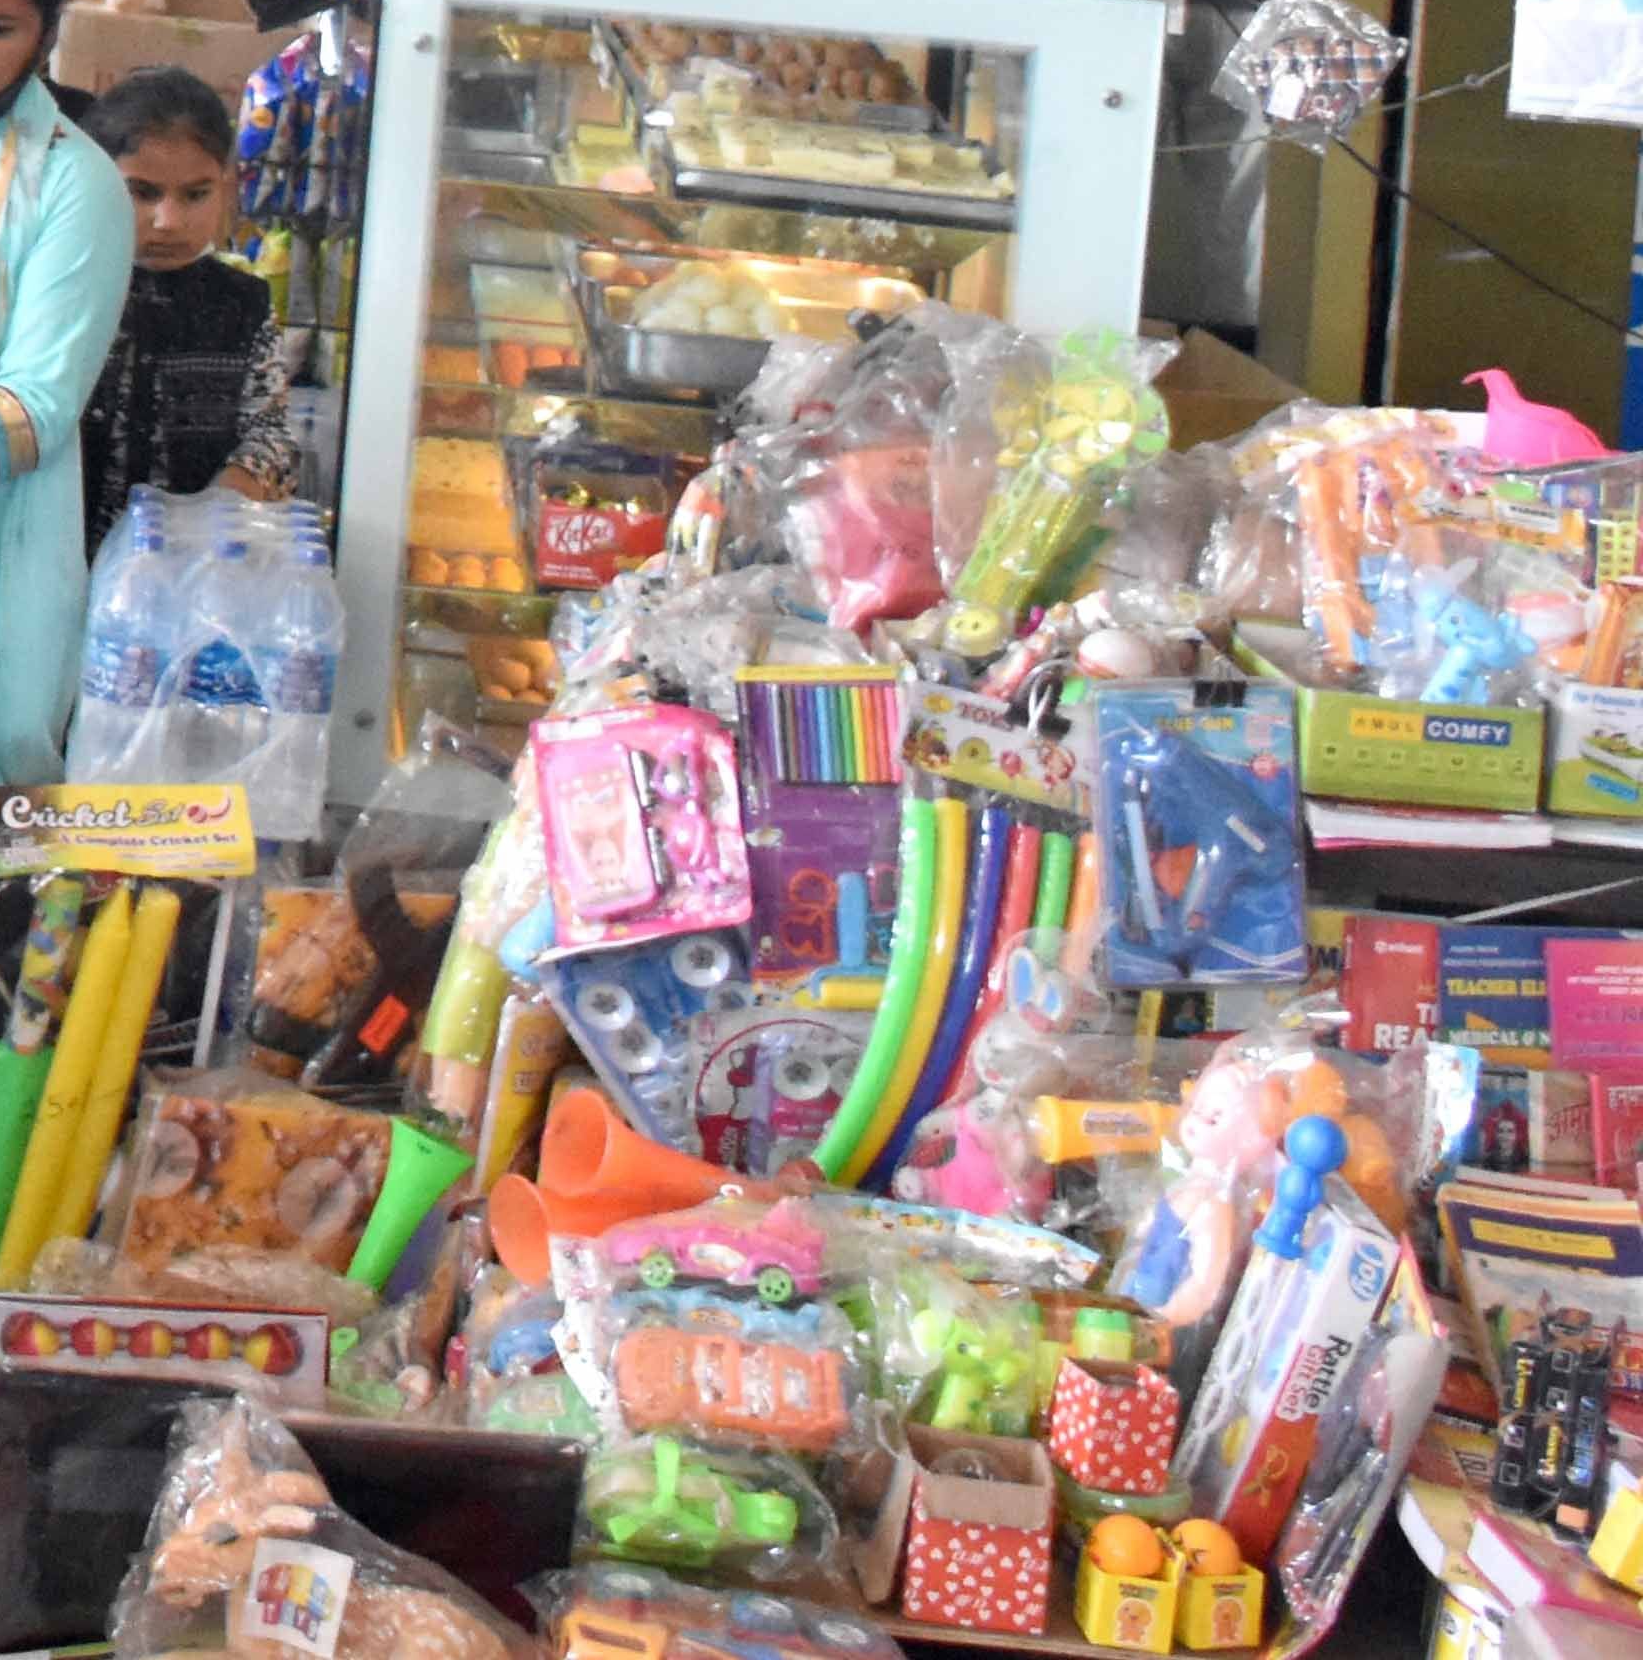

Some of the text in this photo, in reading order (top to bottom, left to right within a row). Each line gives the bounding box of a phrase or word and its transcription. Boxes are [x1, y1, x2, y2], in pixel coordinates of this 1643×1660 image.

[1426, 720, 1508, 742] COMFY
[1, 795, 133, 829] Cricket
[71, 834, 147, 847] Complete
[149, 833, 209, 846] Cricket
[212, 832, 239, 844] Set
[1282, 1344, 1325, 1414] Gift Set
[1304, 1333, 1352, 1409] Rattle
